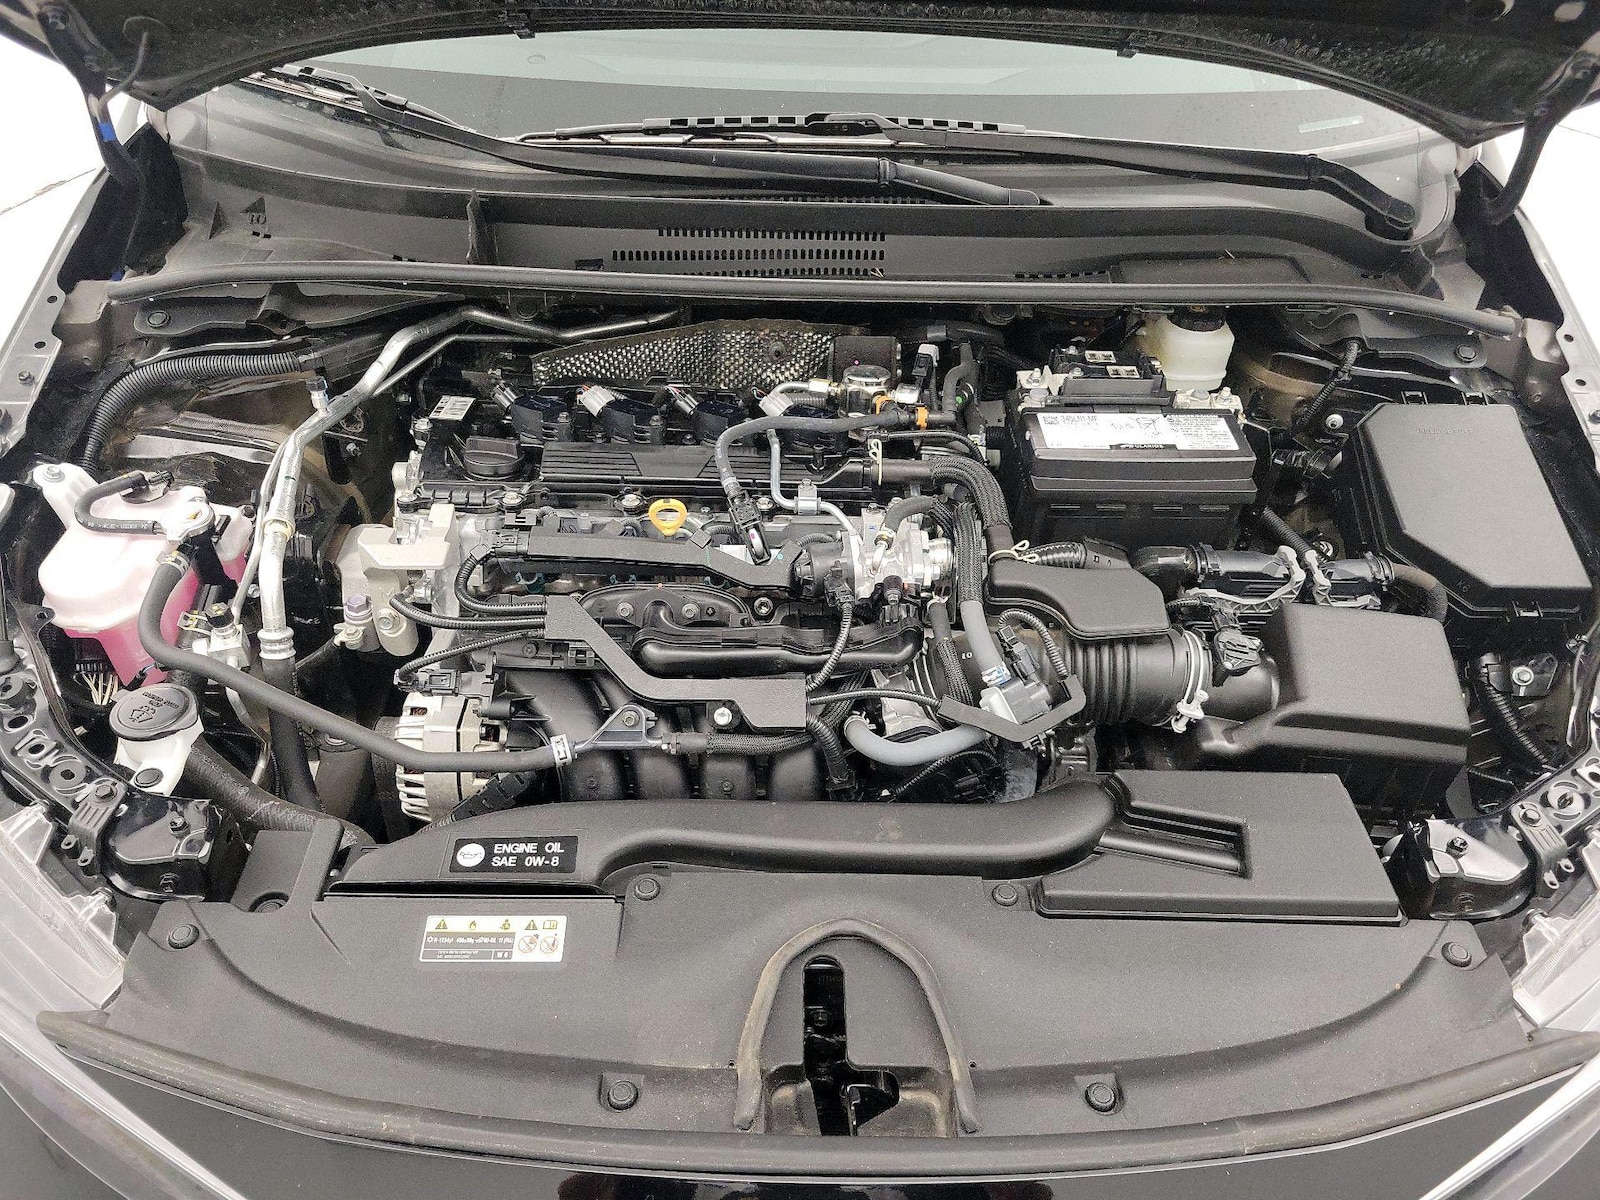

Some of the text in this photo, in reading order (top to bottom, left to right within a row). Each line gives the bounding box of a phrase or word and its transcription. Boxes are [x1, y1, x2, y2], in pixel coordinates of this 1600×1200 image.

[494, 842, 564, 853] ENGINE OIL
[491, 856, 559, 866] SAE 0W-8
